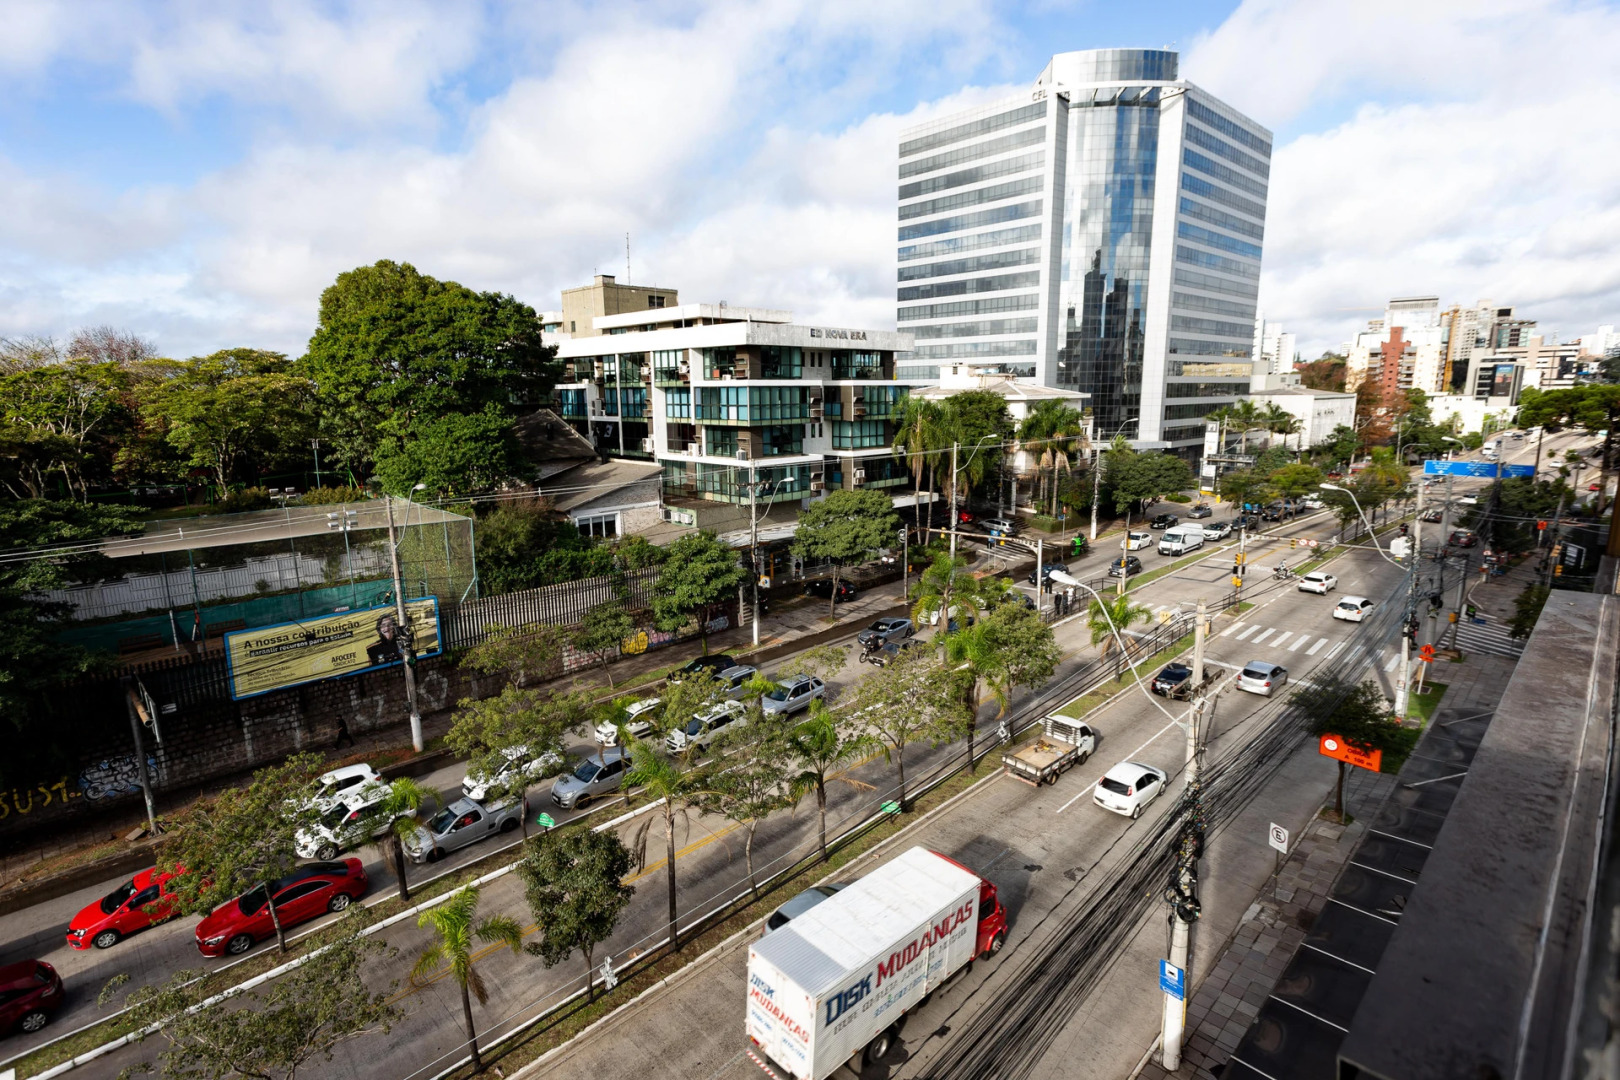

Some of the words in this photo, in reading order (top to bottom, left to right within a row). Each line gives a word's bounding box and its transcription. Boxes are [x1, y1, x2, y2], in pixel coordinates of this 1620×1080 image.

[825, 329, 849, 340] NOVA
[850, 331, 867, 341] ERA
[243, 638, 253, 650] A
[255, 634, 289, 648] nossa
[250, 647, 279, 658] garantir
[279, 641, 309, 652] recursos
[309, 637, 324, 646] para
[331, 651, 357, 663] AFOCEFE
[332, 658, 356, 667] SINDICATO
[750, 973, 776, 999] DISK
[749, 987, 810, 1044] MUDANÇAS
